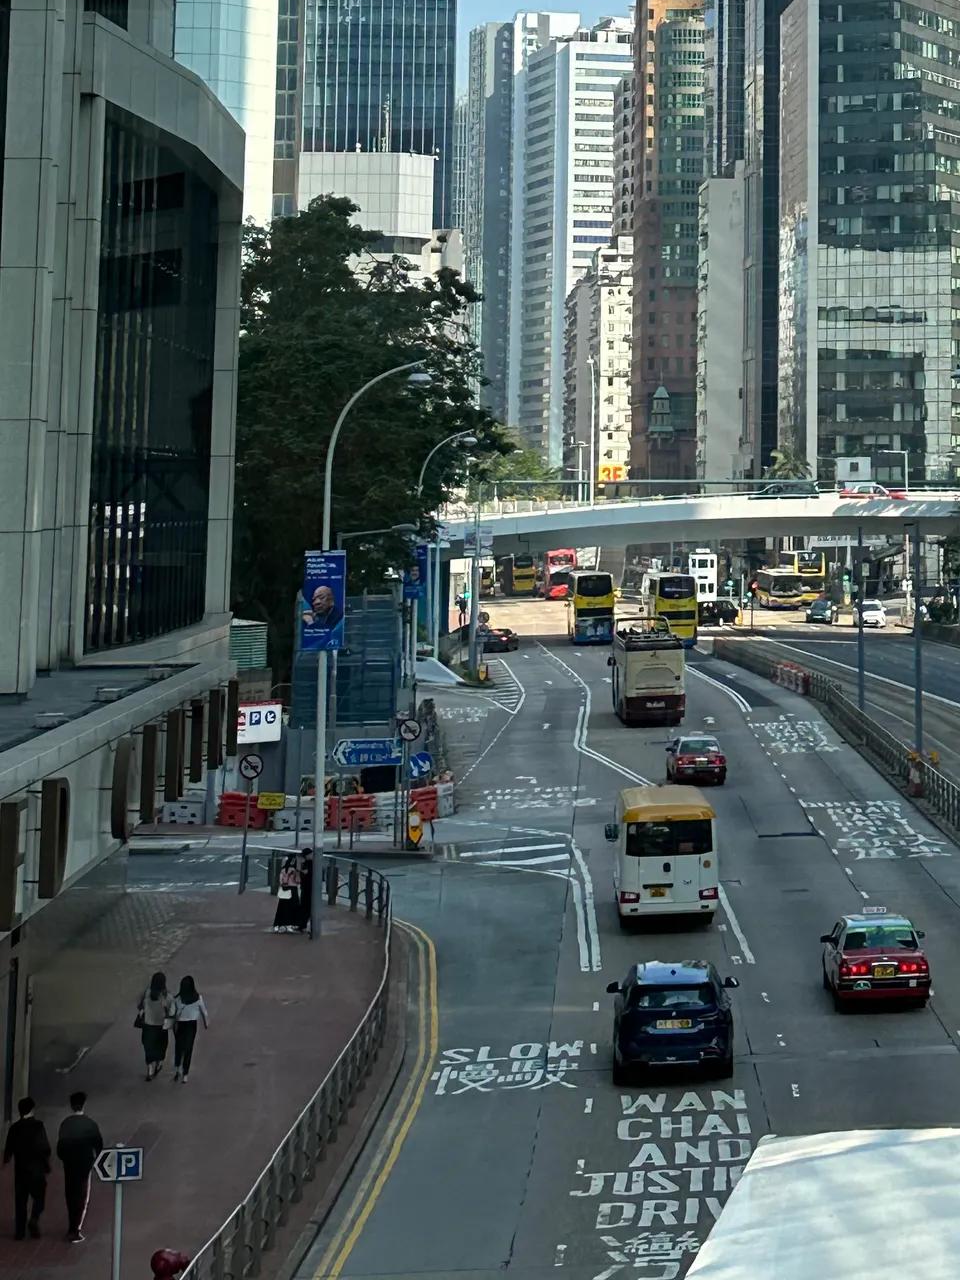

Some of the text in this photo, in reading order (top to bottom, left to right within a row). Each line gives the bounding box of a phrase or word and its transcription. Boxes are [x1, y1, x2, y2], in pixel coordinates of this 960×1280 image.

[439, 1040, 584, 1065] SLOW
[620, 1089, 747, 1115] WAN
[617, 1113, 751, 1141] CHAI
[121, 1154, 136, 1176] P
[629, 1138, 751, 1168] AND
